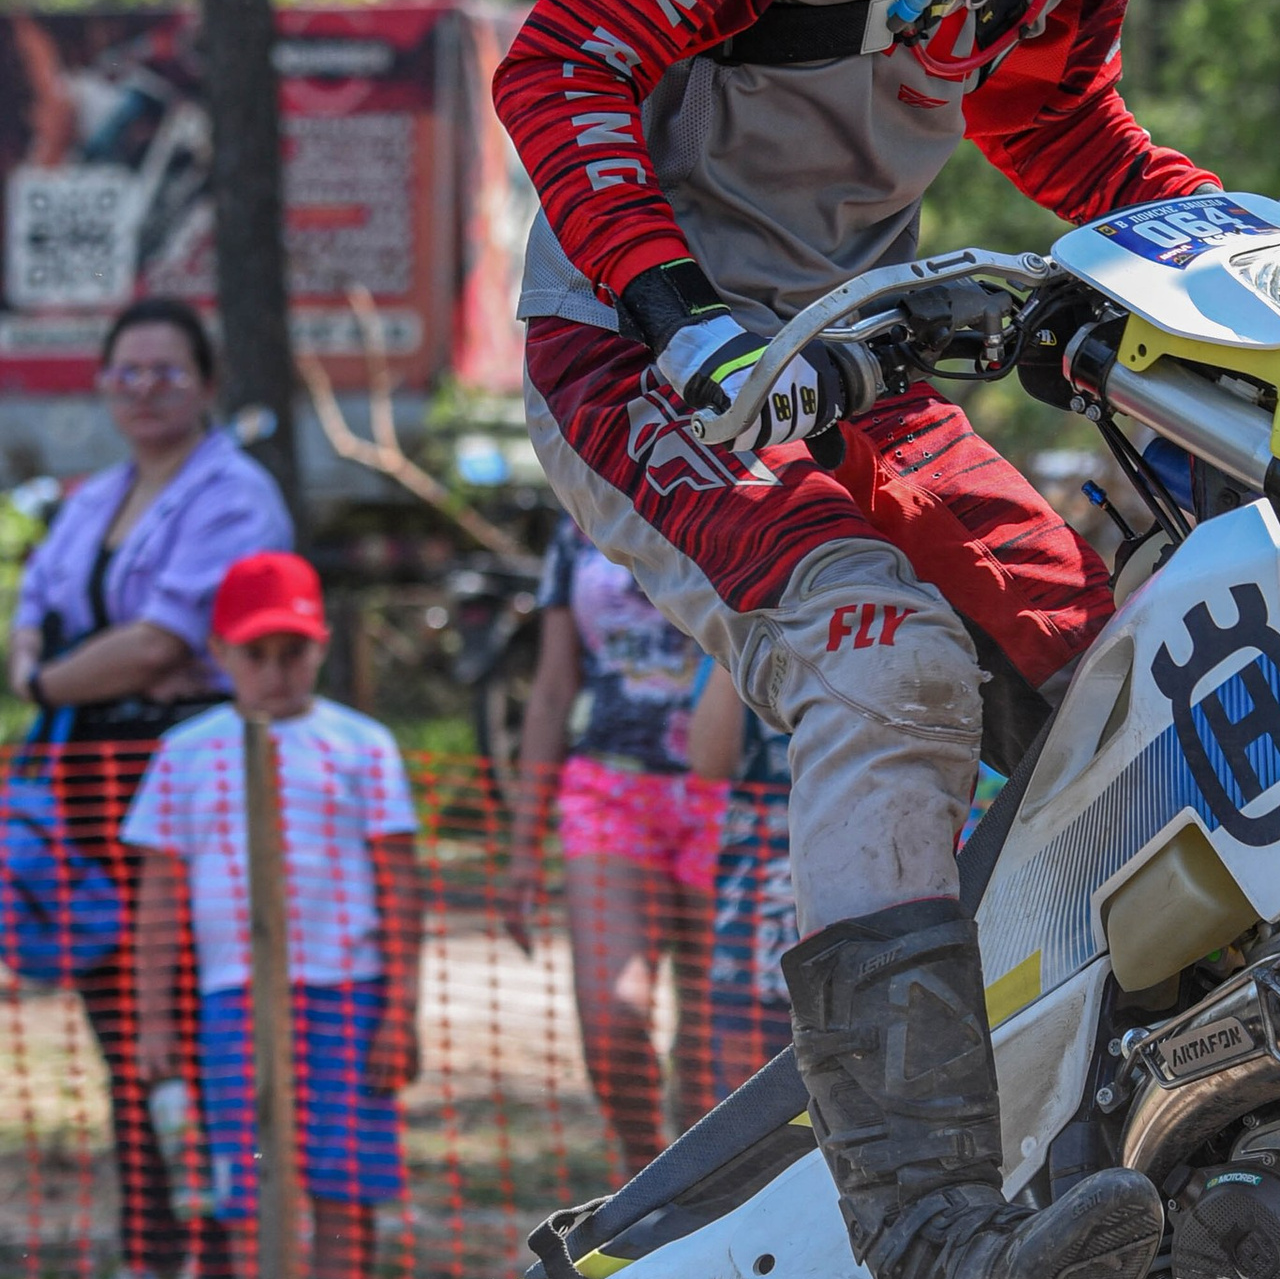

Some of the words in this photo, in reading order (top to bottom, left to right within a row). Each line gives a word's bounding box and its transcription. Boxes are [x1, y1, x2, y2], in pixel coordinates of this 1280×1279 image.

[562, 25, 648, 192] RING
[1129, 204, 1179, 224] ПОИСКЕ
[1131, 207, 1255, 250] 064
[826, 603, 918, 653] FLY
[1172, 1025, 1242, 1068] ARTAFON
[1218, 1172, 1261, 1186] MOTOREX
